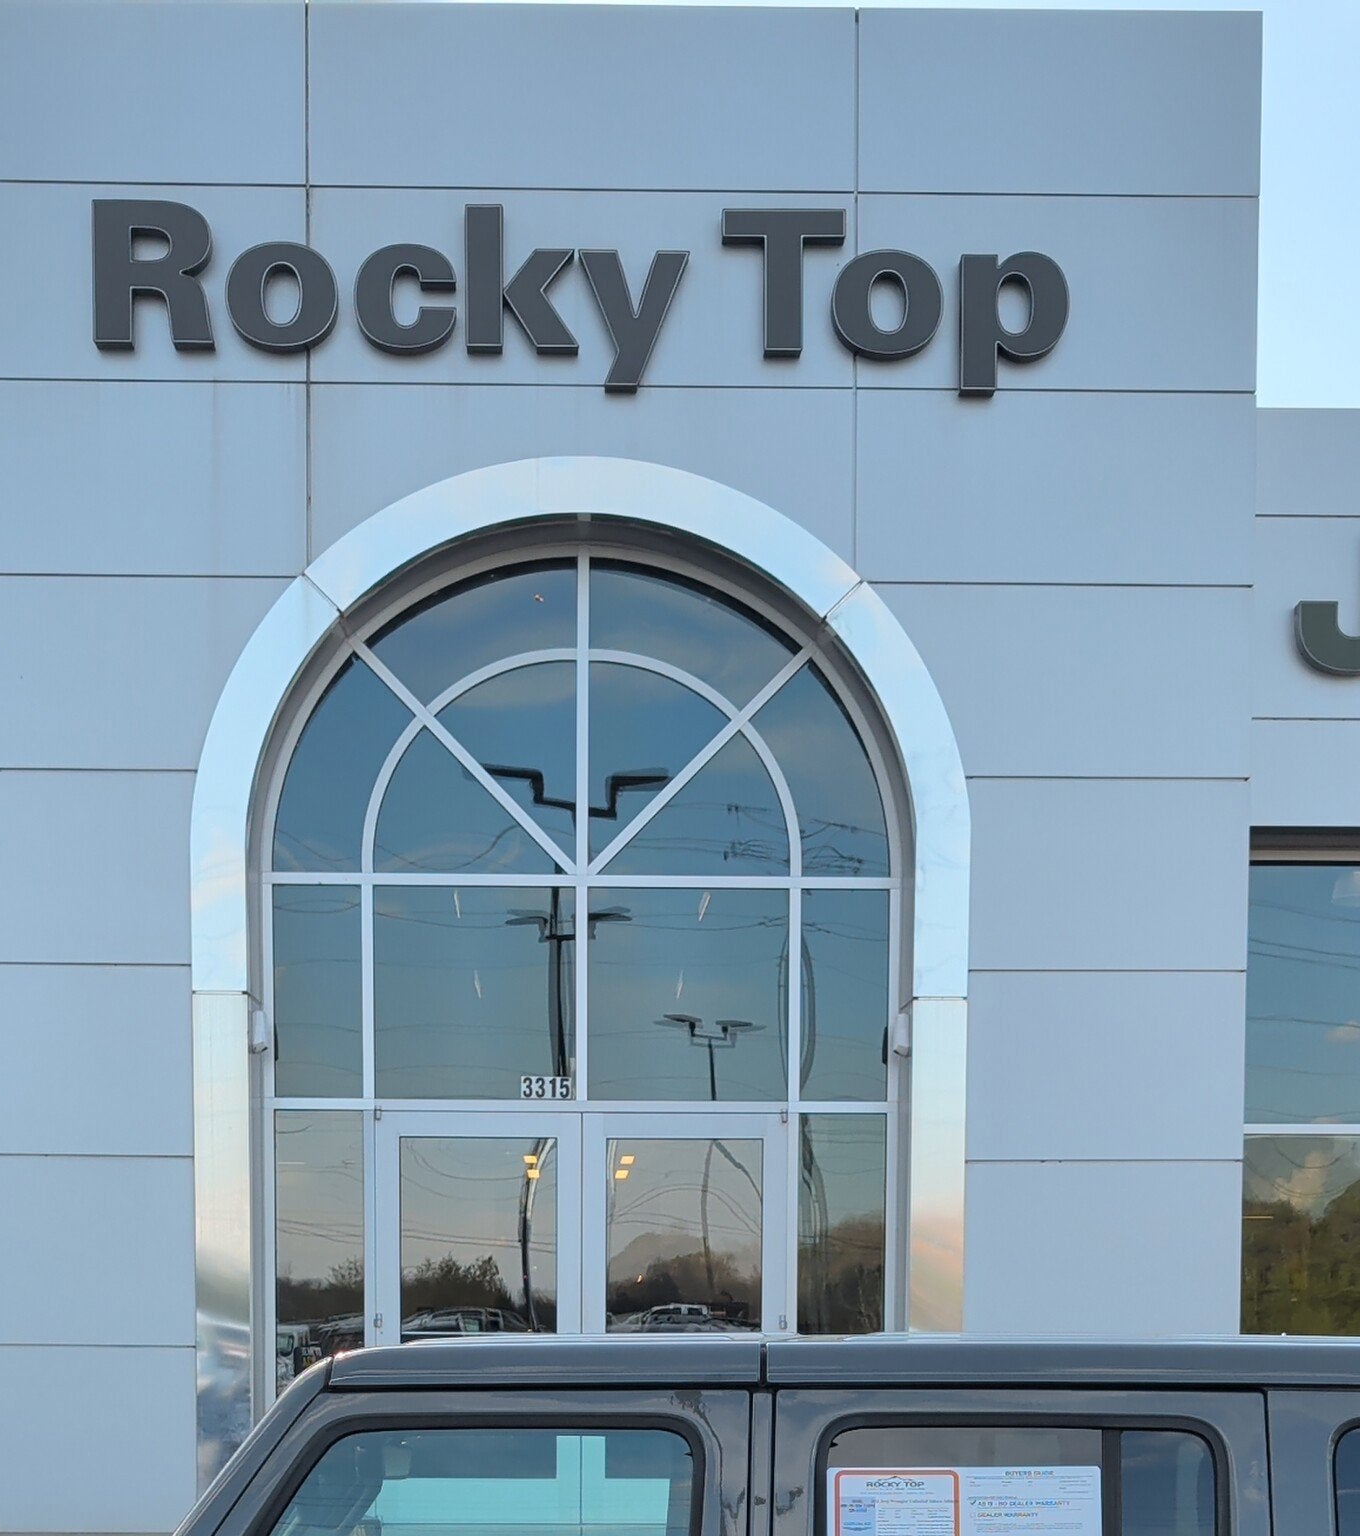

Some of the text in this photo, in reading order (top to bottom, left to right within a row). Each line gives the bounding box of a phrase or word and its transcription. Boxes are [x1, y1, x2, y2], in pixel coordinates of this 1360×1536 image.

[91, 199, 1070, 397] Rocky Top
[523, 1077, 570, 1098] 3315
